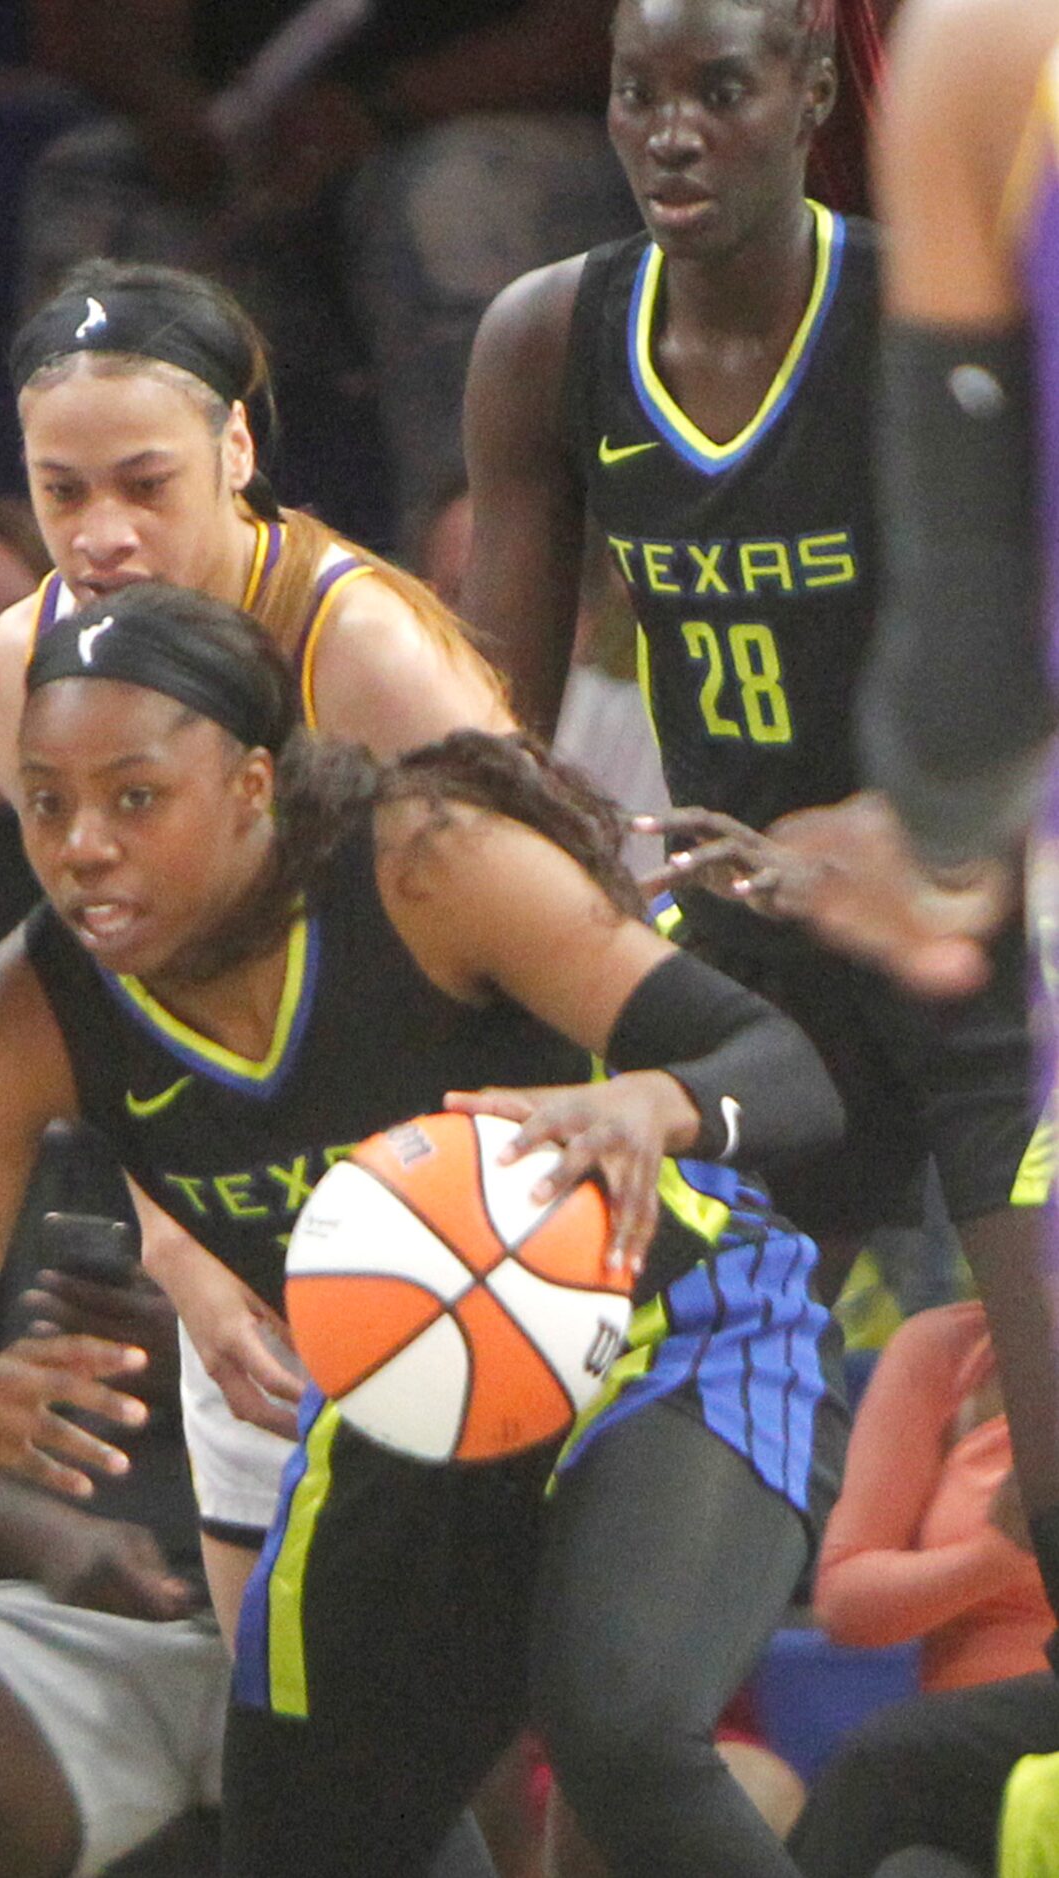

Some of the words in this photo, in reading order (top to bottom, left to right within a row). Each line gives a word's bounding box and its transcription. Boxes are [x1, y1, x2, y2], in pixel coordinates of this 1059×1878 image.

[608, 531, 856, 593] TEXAS
[680, 620, 792, 744] 28
[164, 1143, 356, 1216] TEX
